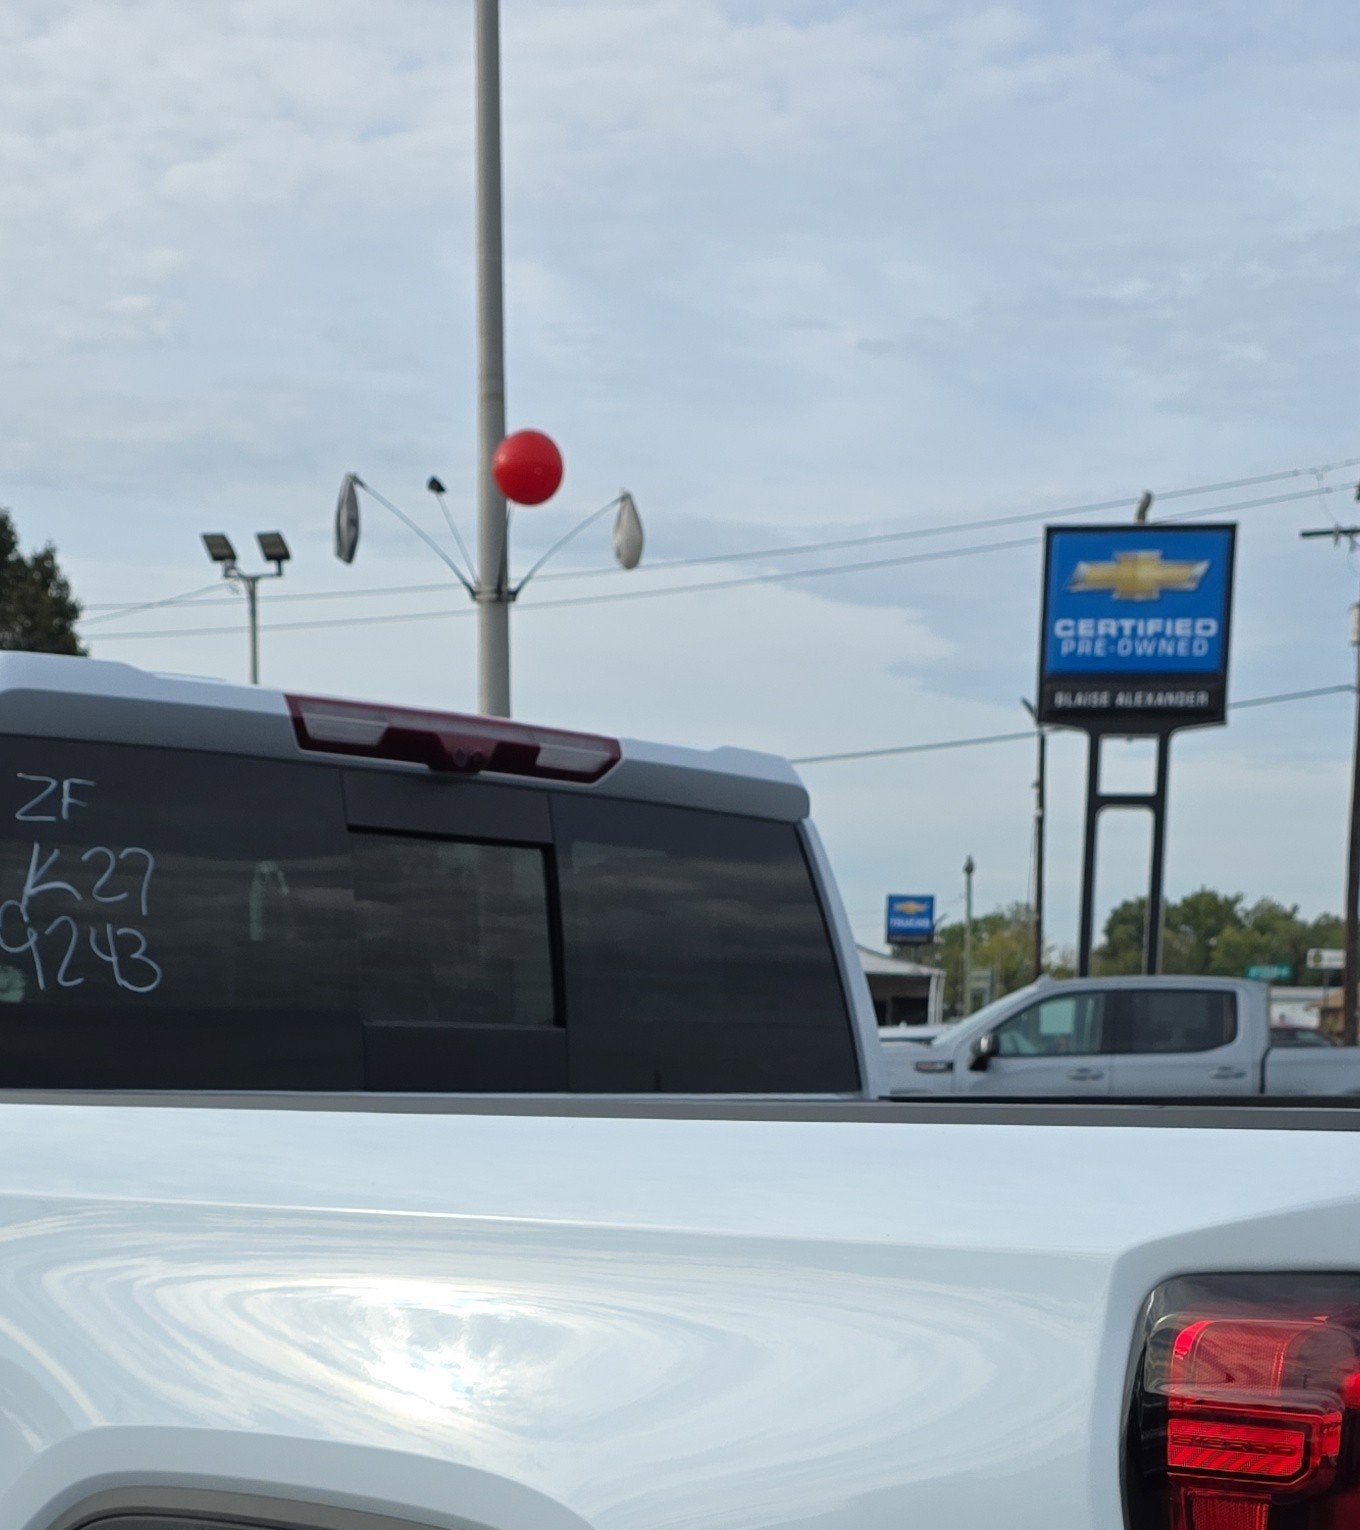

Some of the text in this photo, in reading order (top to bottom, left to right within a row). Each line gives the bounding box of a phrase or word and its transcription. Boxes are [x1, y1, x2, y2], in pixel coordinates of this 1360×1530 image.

[1053, 618, 1218, 639] CERTIFIED
[1060, 637, 1209, 658] PRE-OWNED
[1054, 690, 1210, 708] BLAISE ALEXANDER
[15, 772, 98, 822] ZF
[20, 841, 157, 919] K27
